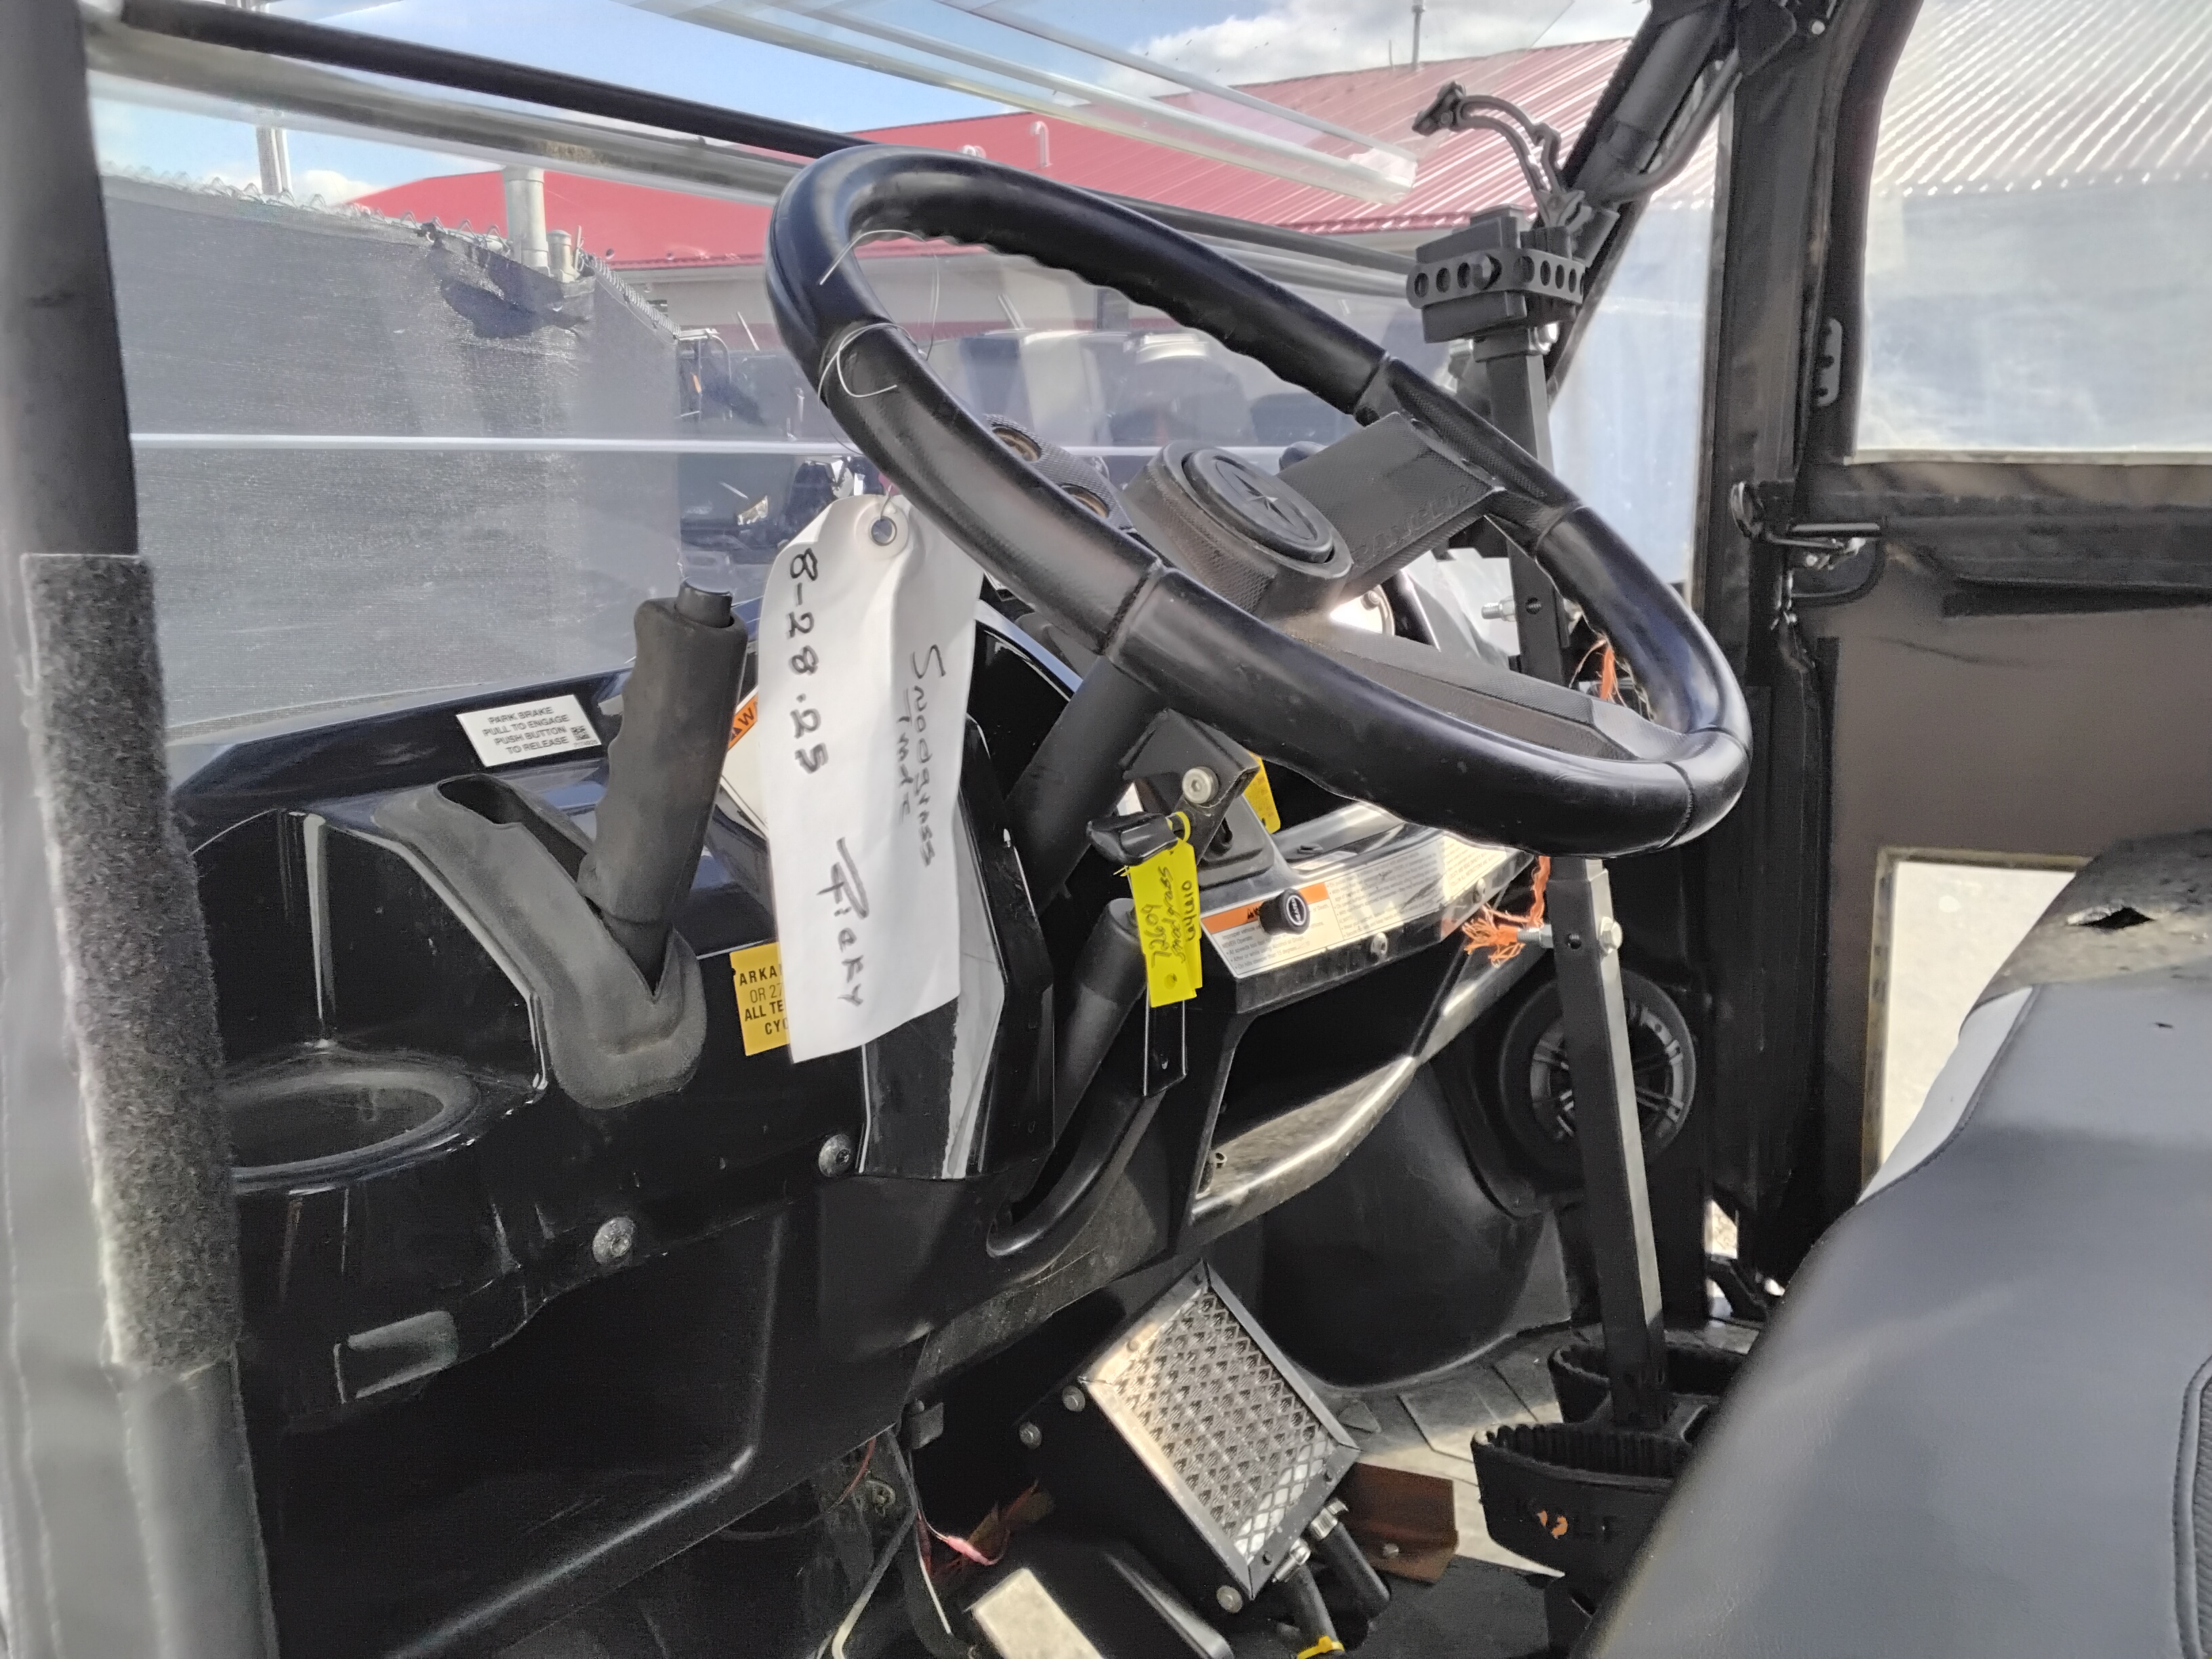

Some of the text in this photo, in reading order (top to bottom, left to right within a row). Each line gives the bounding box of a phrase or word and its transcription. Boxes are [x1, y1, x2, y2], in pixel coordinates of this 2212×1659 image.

[487, 706, 554, 725] PARK BRAKE
[482, 714, 571, 737] PULL TO ENGAGE
[493, 725, 567, 746] PUSH BUTTON
[506, 736, 570, 755] TO RELEASE
[750, 987, 766, 1004] OR
[744, 1005, 767, 1022] ALL
